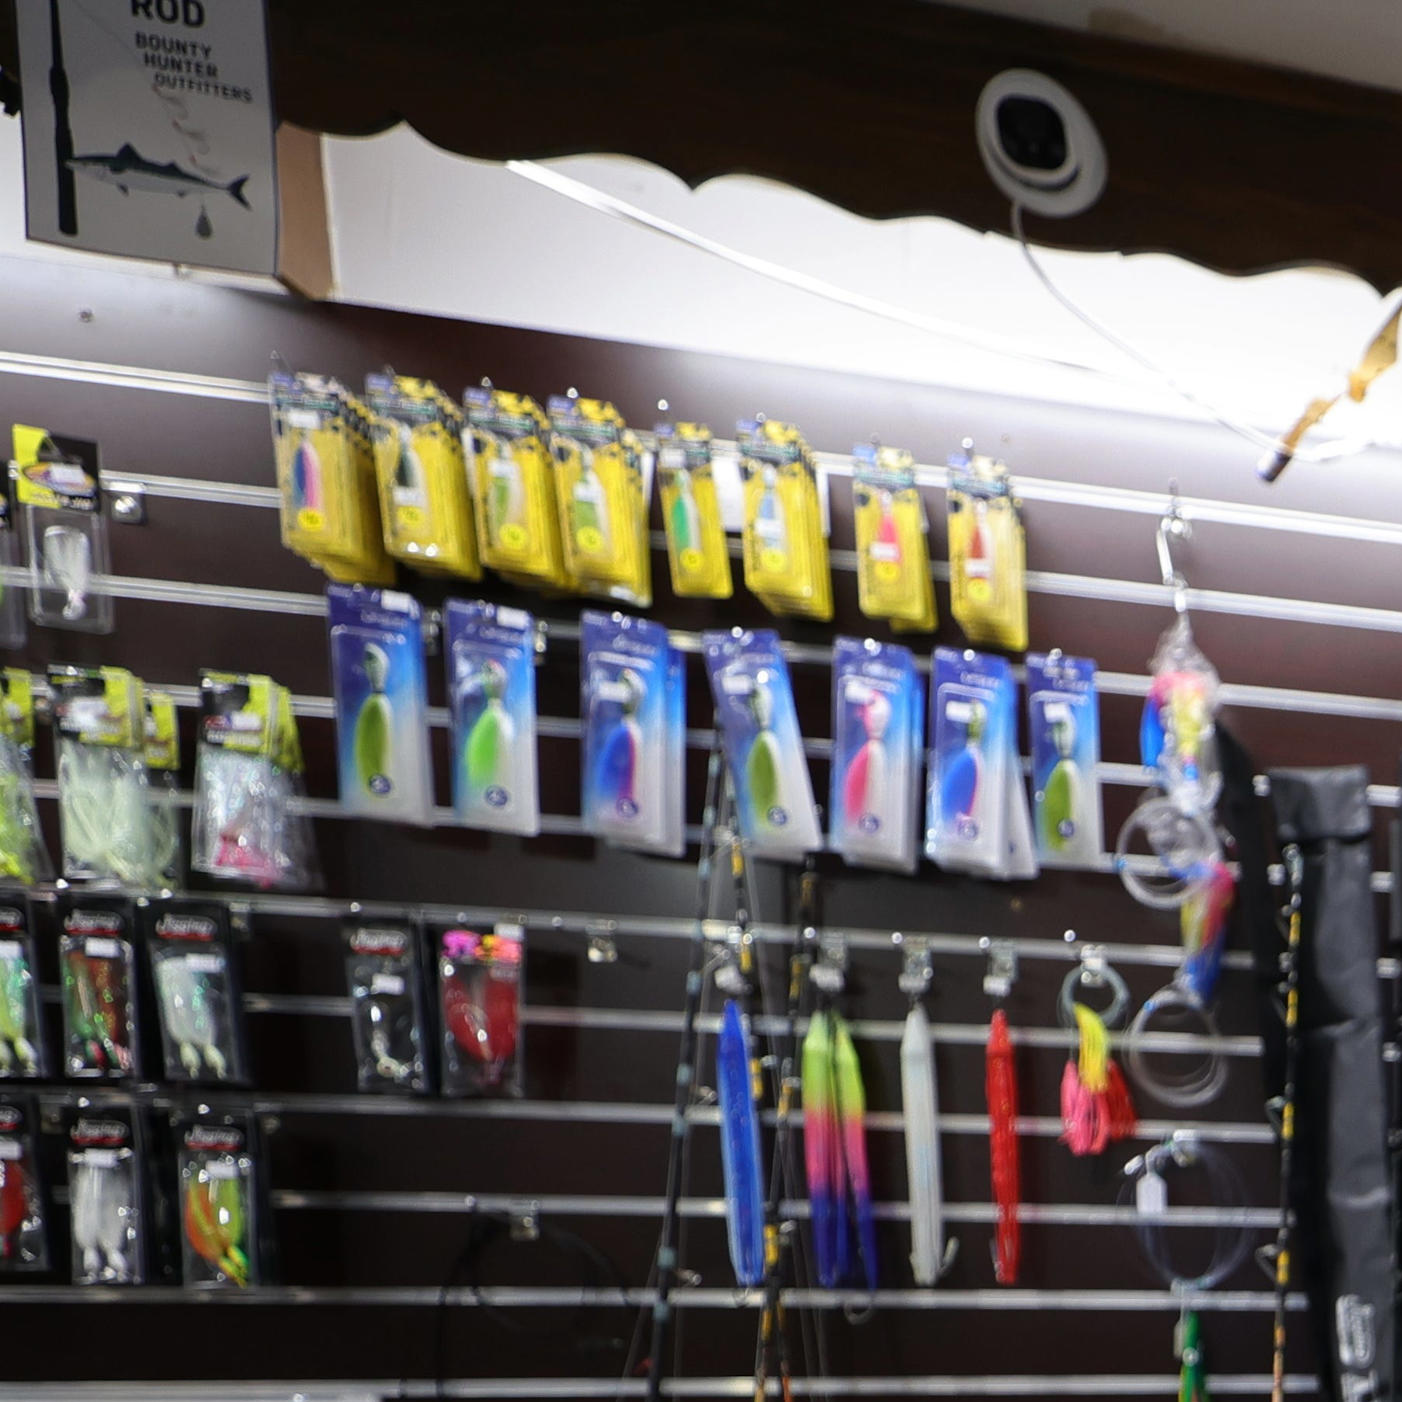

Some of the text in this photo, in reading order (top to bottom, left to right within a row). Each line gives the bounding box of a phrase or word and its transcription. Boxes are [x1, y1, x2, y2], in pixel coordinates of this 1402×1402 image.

[131, 0, 206, 28] ROD
[136, 31, 212, 59] BOUNTY
[144, 52, 218, 78] HUNTER
[154, 72, 253, 104] OUTFITTERS
